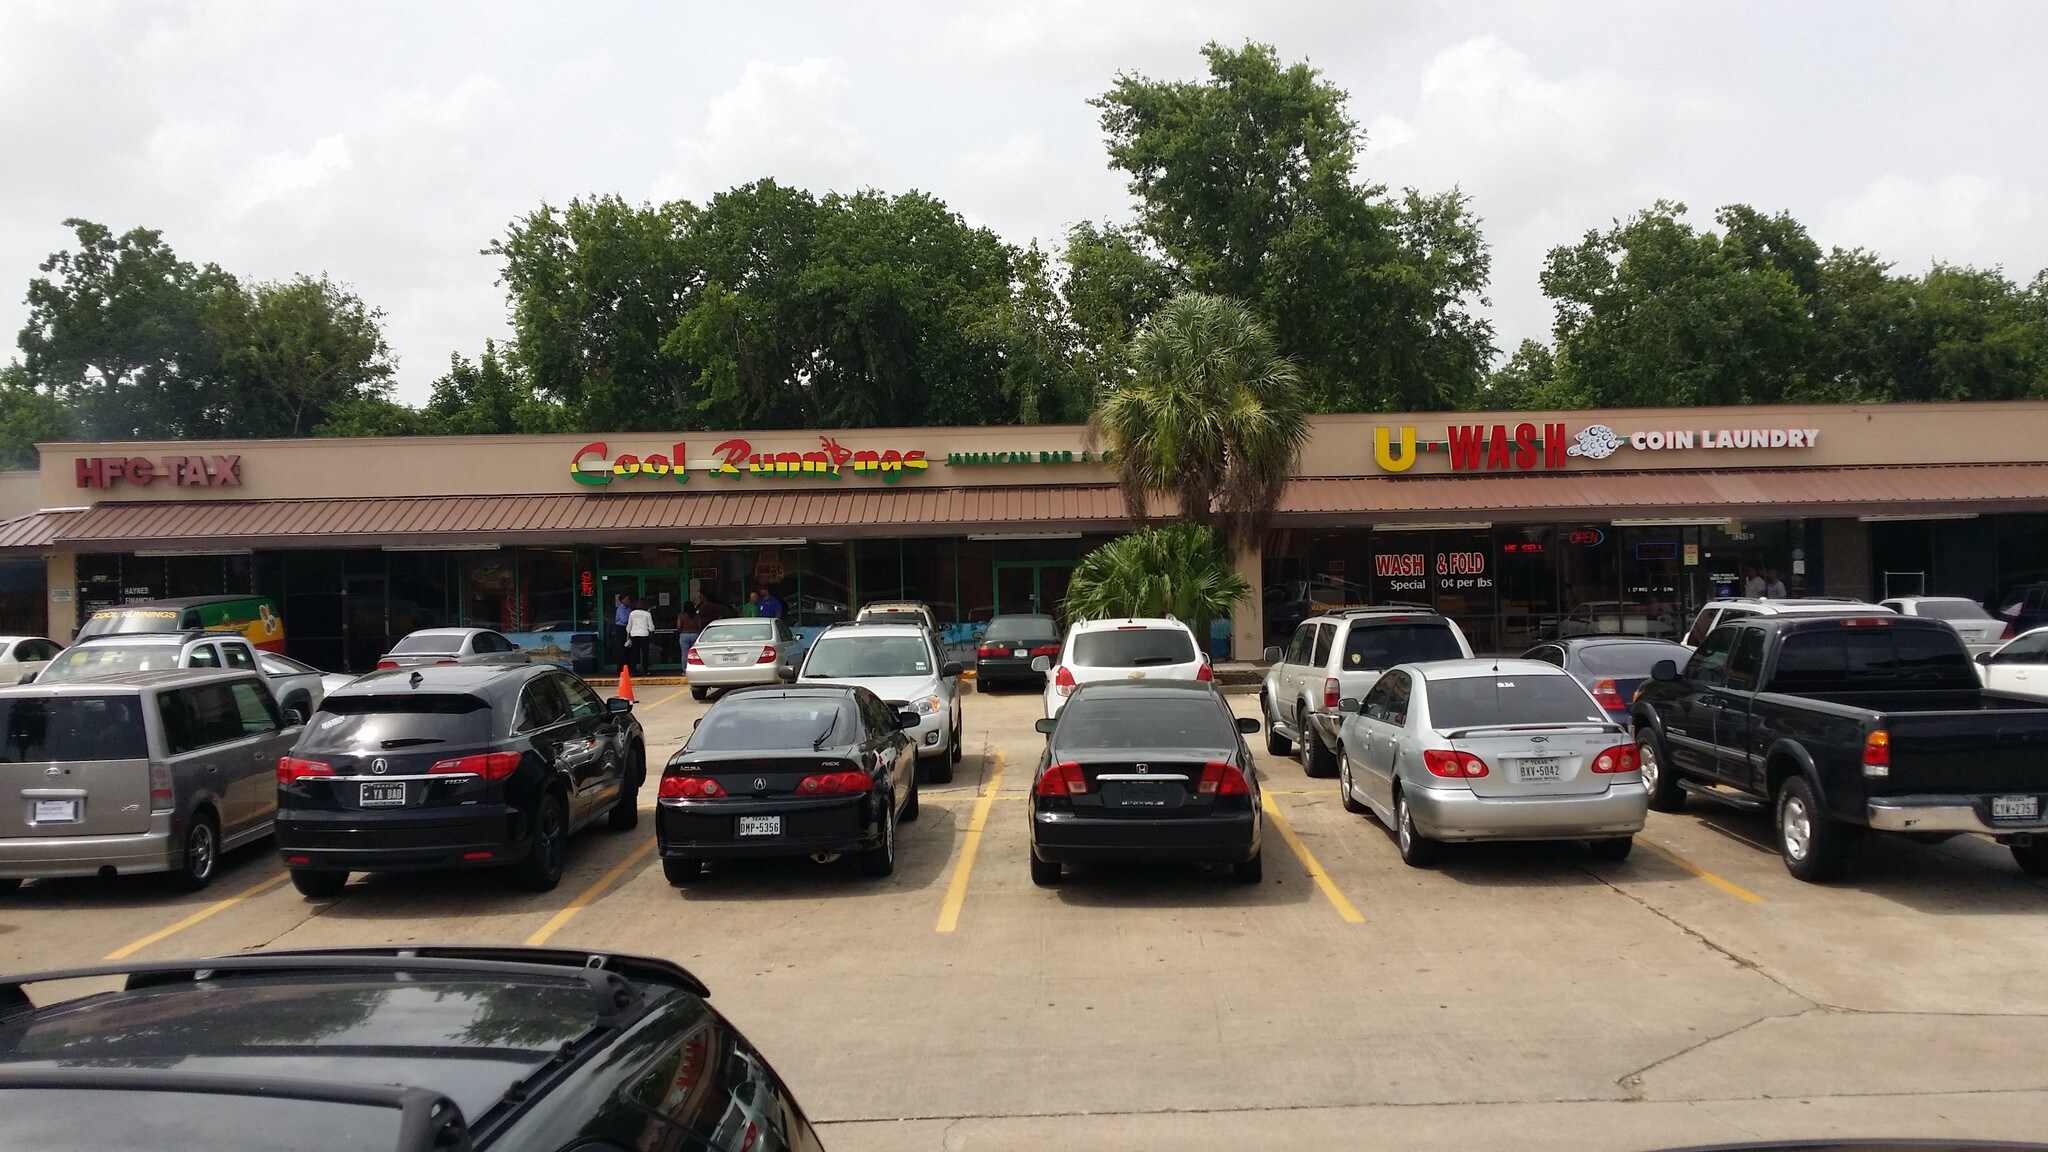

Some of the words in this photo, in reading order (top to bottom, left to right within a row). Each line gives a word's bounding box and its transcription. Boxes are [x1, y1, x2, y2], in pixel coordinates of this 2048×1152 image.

[1630, 431, 1694, 450] COIN
[1701, 429, 1820, 449] LAUNDRY
[571, 442, 690, 487] Cool
[944, 451, 1032, 467] JAMAICAN
[1039, 450, 1073, 465] BAR
[75, 457, 153, 488] HFC
[161, 455, 241, 487] TAX
[1569, 530, 1599, 545] OPEN
[1375, 554, 1424, 576] WASH
[1436, 553, 1448, 575] &
[1450, 552, 1484, 574] FOLD
[124, 586, 149, 595] HAYNES
[1390, 580, 1426, 591] Special
[1457, 579, 1475, 589] per
[1477, 578, 1493, 588] lbs
[92, 611, 118, 620] COOL
[120, 610, 177, 619] RUNNINGS
[373, 789, 383, 799] YA
